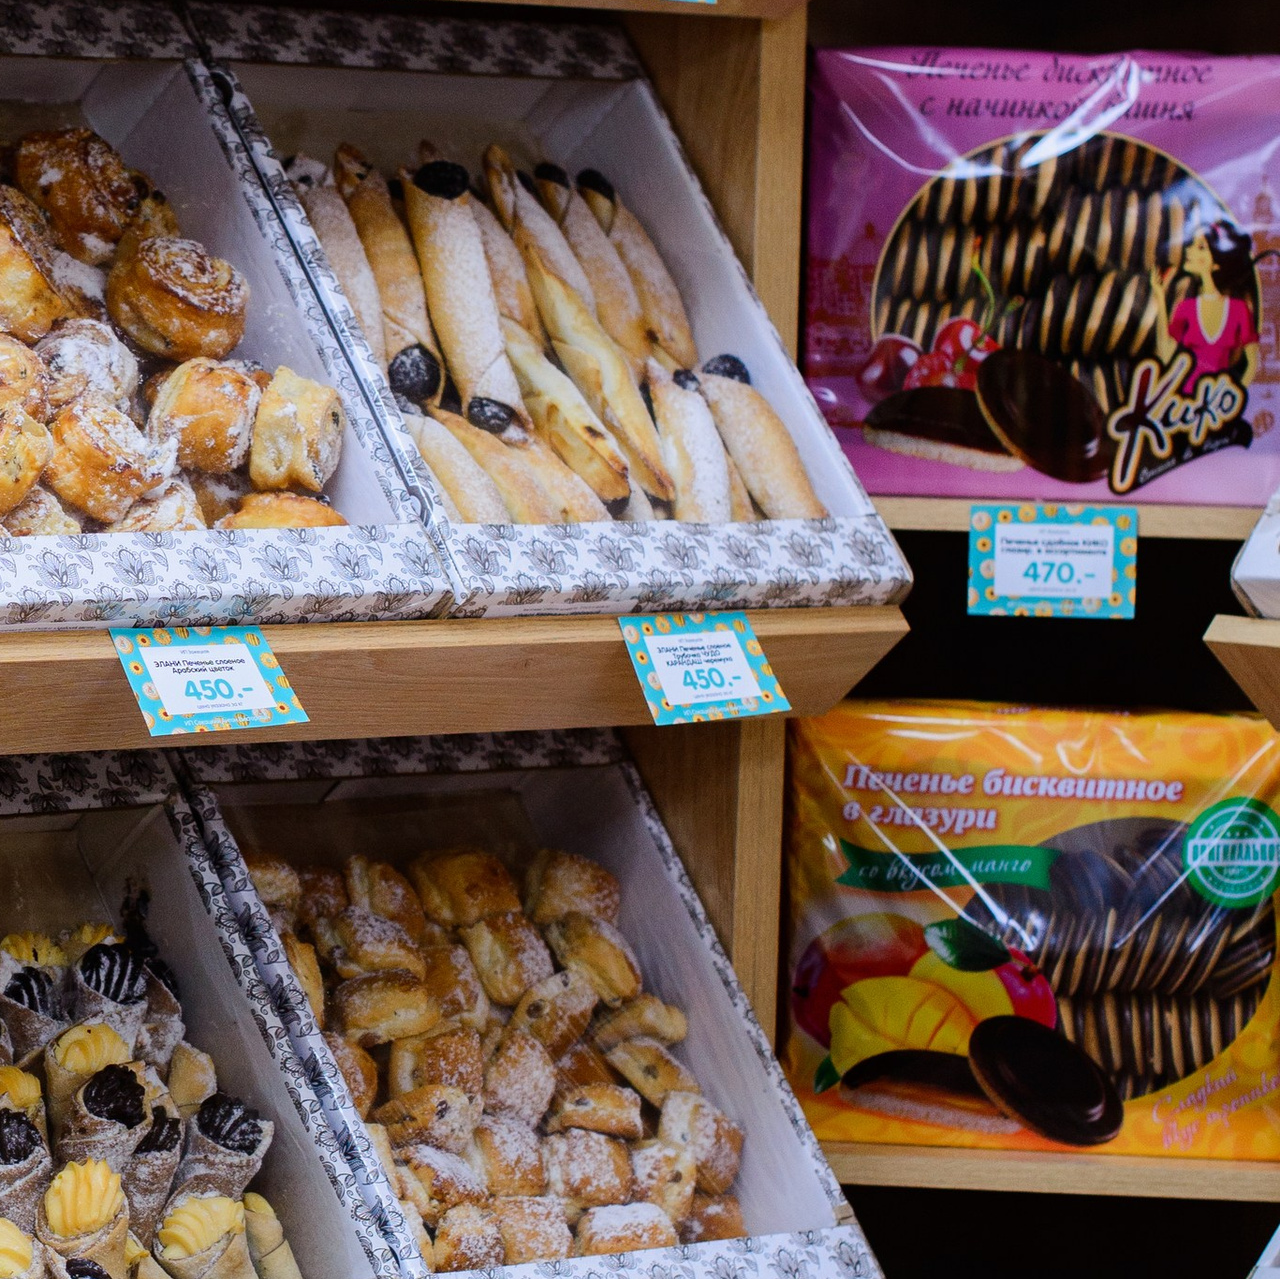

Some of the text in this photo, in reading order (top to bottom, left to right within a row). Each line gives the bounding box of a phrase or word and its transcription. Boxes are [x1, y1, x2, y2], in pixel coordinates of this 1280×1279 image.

[702, 650, 720, 658] ЧУДО
[154, 660, 181, 668] ЭЛАНИ
[182, 659, 214, 667] Печенье
[172, 665, 234, 675] Арабский цветок
[842, 763, 1184, 802] Печенье бисквитное
[869, 803, 997, 834] глазури
